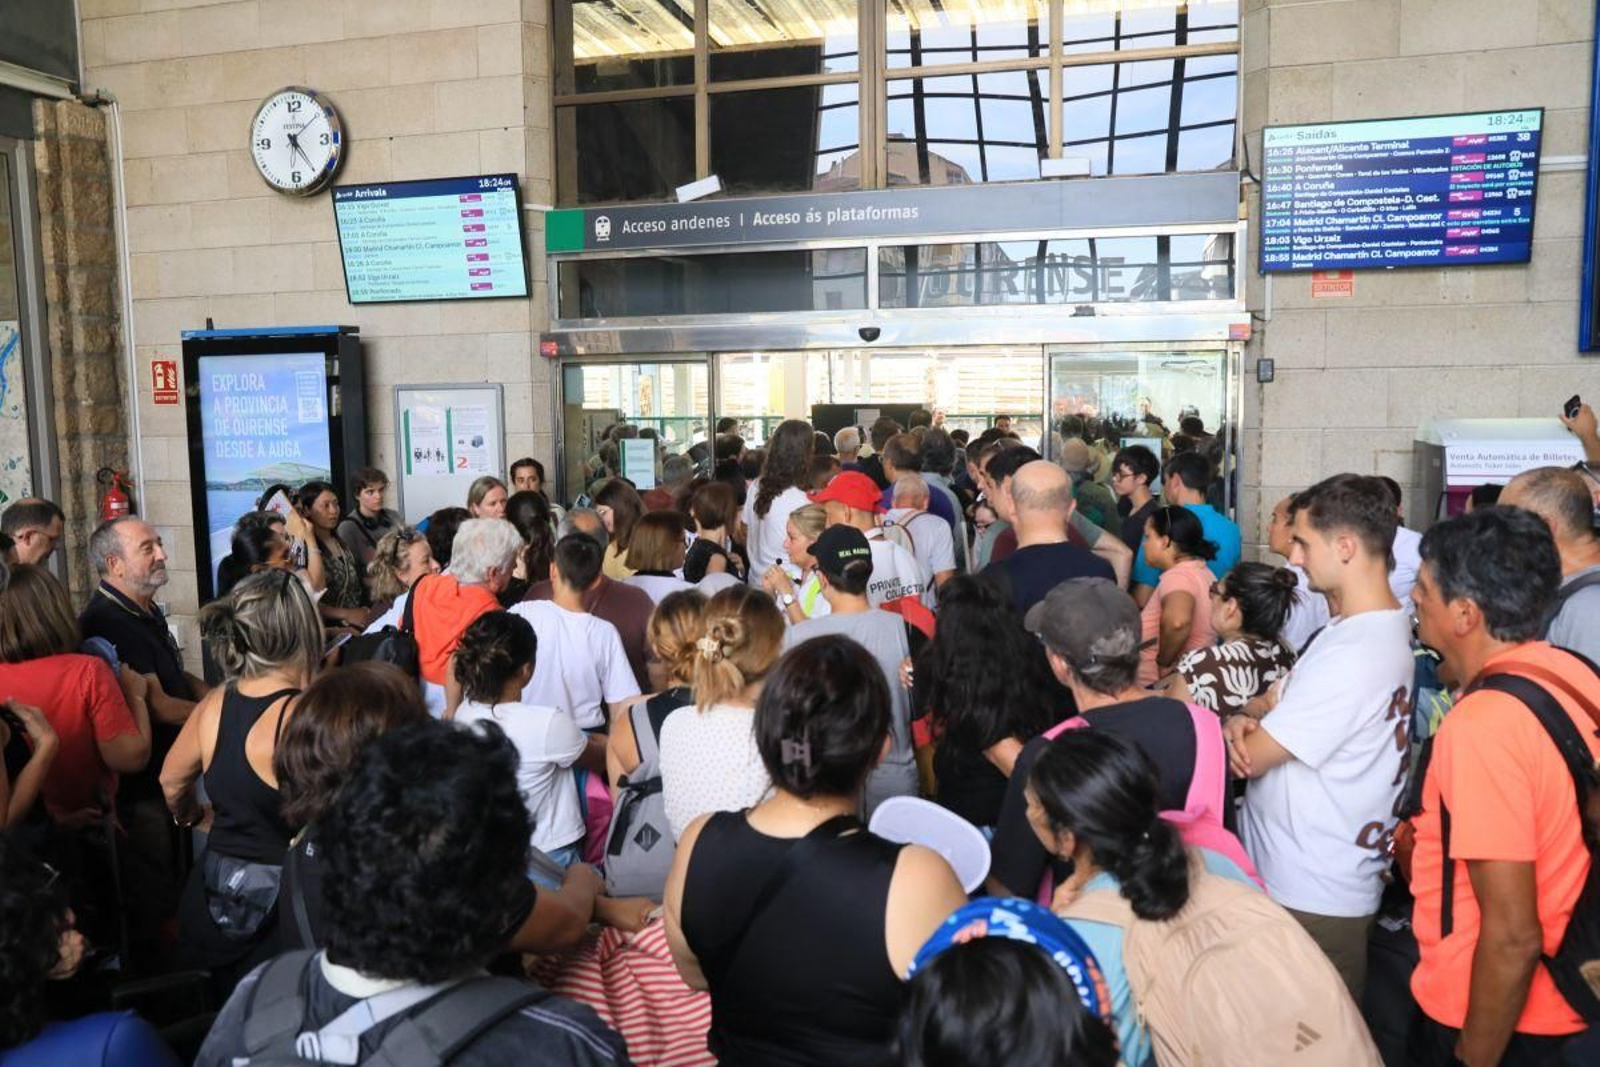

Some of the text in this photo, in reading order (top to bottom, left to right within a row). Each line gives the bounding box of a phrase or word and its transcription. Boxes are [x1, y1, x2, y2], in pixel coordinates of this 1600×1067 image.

[287, 100, 302, 113] 12
[1487, 114, 1524, 126] 18:24
[260, 138, 271, 150] 9
[320, 133, 330, 145] 3
[1371, 140, 1410, 151] Terminal
[1295, 162, 1344, 173] Ponferrada
[292, 171, 302, 183] 6
[478, 177, 504, 188] 18:24
[1267, 180, 1335, 192] 16:40 A Coruña
[355, 187, 388, 198] Arrivals
[1266, 201, 1292, 210] 16:47
[1294, 199, 1333, 210] Santiago
[1334, 199, 1346, 207] de
[1416, 194, 1441, 203] Cast.
[1514, 207, 1521, 216] 5
[622, 205, 918, 234] Acceso andenes Acceso ás plataformas
[1266, 219, 1291, 227] 17:04
[1294, 217, 1324, 226] Madrid
[1387, 211, 1443, 223] Campoamor
[1265, 234, 1342, 245] 18:03 Vigo Urzaiz
[1292, 252, 1322, 261] Madrid
[1385, 247, 1440, 260] Campoamor
[212, 373, 266, 392] EXPLORA
[213, 395, 288, 414] A PROVINCIA
[215, 418, 288, 436] DE OURENSE
[216, 440, 301, 458] DESDE A AUGA
[456, 456, 468, 469] 2
[1450, 452, 1474, 461] Venta
[1531, 453, 1540, 461] de
[1543, 452, 1578, 461] Billetes
